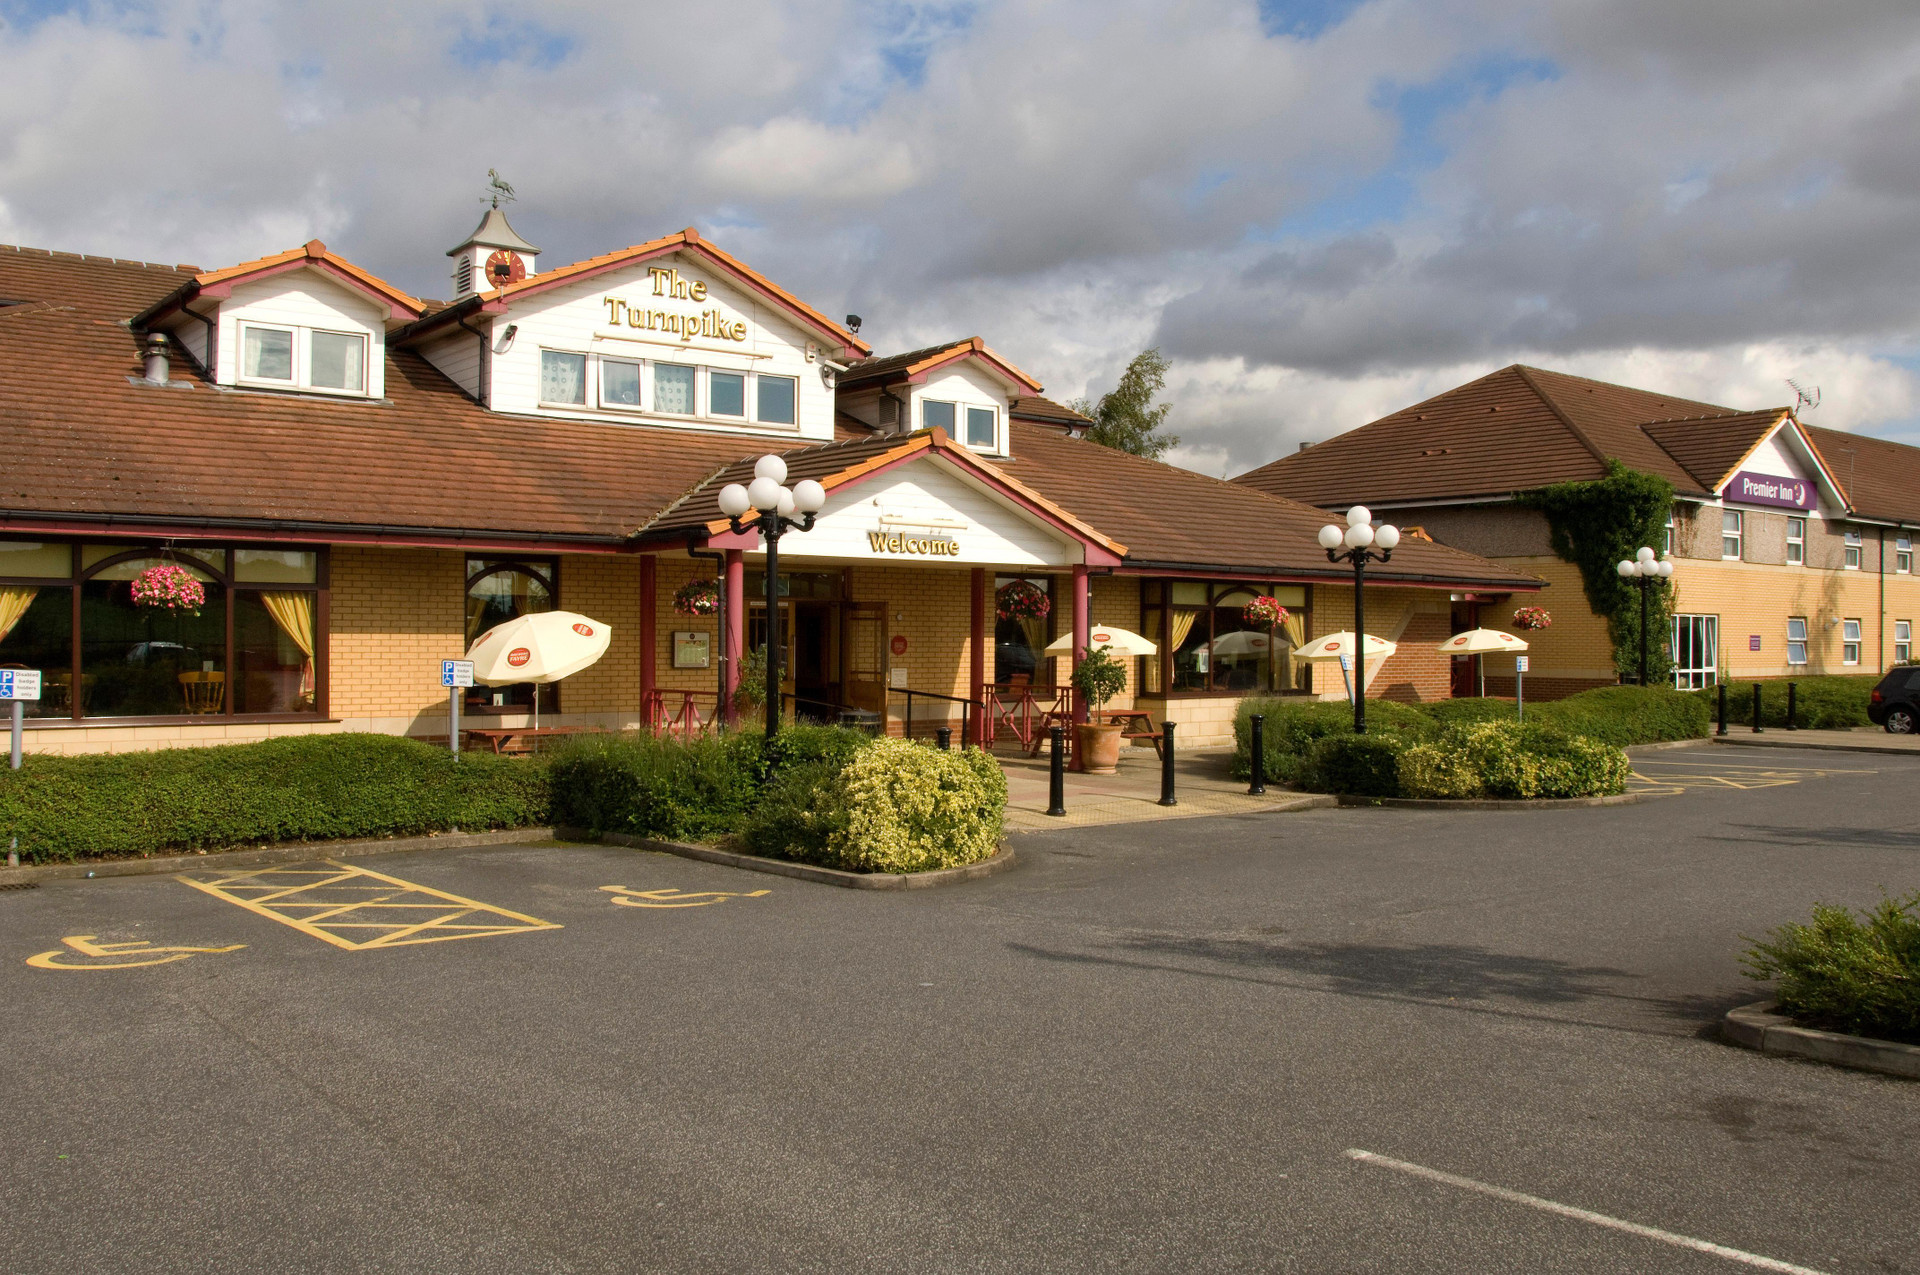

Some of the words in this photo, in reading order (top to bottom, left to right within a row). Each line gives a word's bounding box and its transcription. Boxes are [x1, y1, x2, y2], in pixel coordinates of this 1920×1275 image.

[649, 267, 707, 301] The
[604, 296, 747, 341] Turnpike
[1743, 477, 1778, 499] Premier
[1780, 483, 1793, 501] Inn
[868, 531, 960, 556] Welcome
